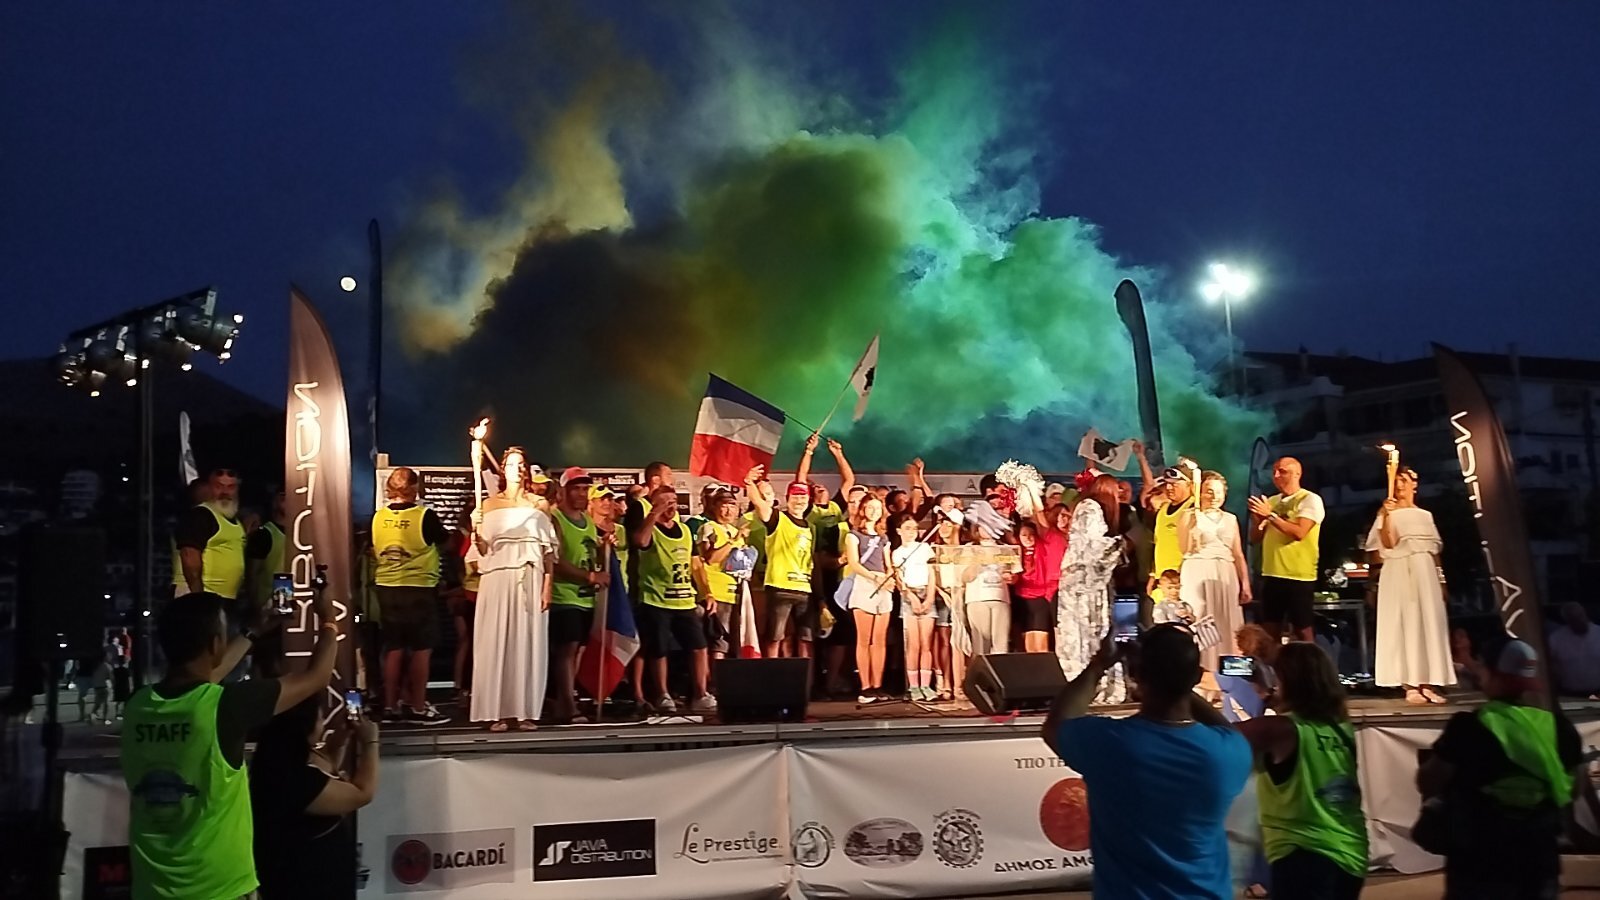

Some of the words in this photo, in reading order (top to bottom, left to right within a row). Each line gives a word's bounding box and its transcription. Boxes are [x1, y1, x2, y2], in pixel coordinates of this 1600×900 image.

[383, 518, 411, 530] STAFF
[135, 722, 191, 743] STAFF
[1014, 757, 1045, 769] ΥΠΟ
[570, 839, 608, 853] JAVA
[673, 822, 709, 864] Le
[703, 830, 779, 854] Prestige
[432, 842, 507, 870] BACARDÍ
[570, 848, 652, 864] DISTRIBUTION
[994, 858, 1057, 873] ΔΗΜΟΣ
